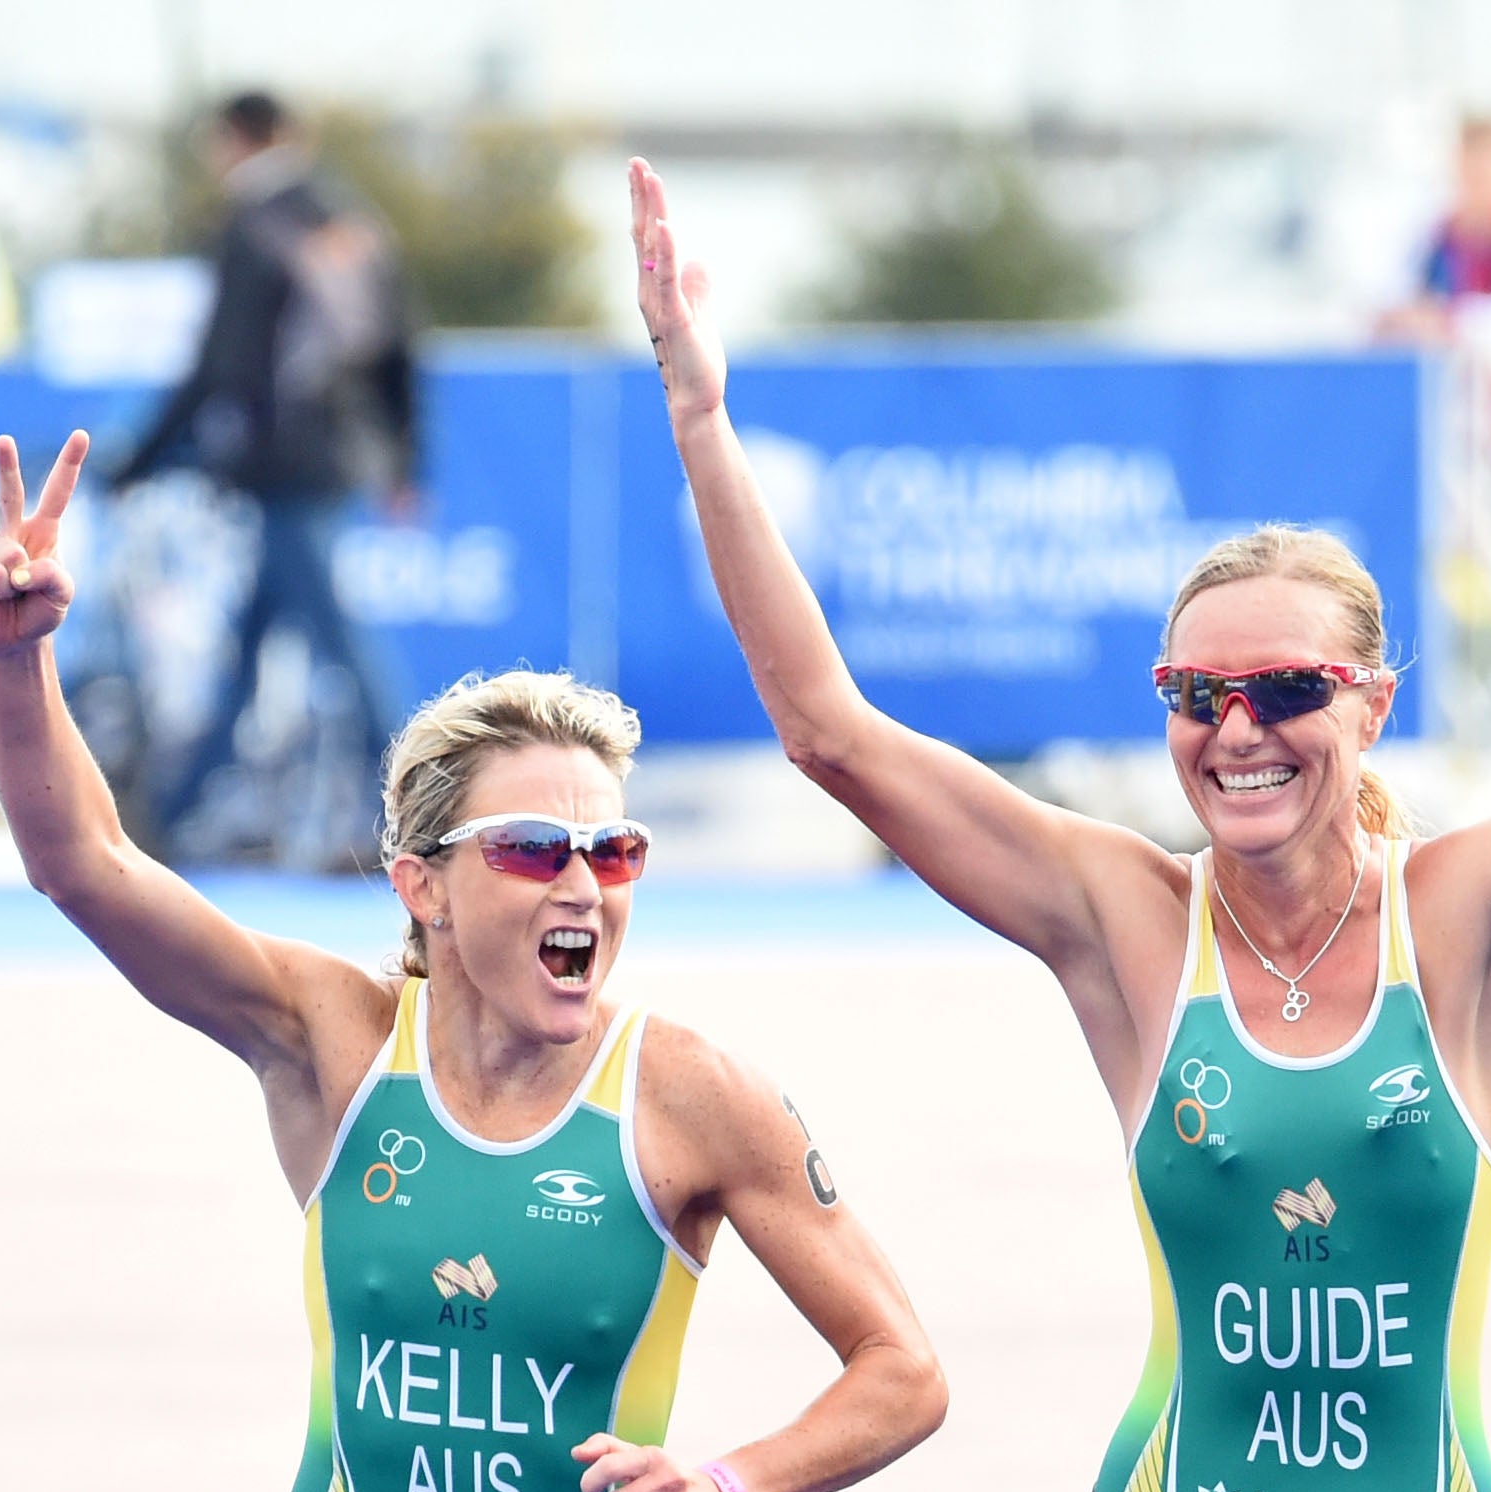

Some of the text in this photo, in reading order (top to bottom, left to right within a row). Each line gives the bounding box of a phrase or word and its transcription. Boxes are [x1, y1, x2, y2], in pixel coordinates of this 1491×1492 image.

[1365, 1109, 1431, 1129] SCODY
[1208, 1133, 1225, 1146] ITU
[394, 1194, 412, 1207] ITU
[525, 1204, 603, 1227] SCODY
[1284, 1235, 1331, 1263] AIS
[437, 1303, 488, 1331] AIS
[1214, 1282, 1413, 1370] GUIDE
[356, 1333, 574, 1436] KELLY
[1246, 1390, 1369, 1470] AUS
